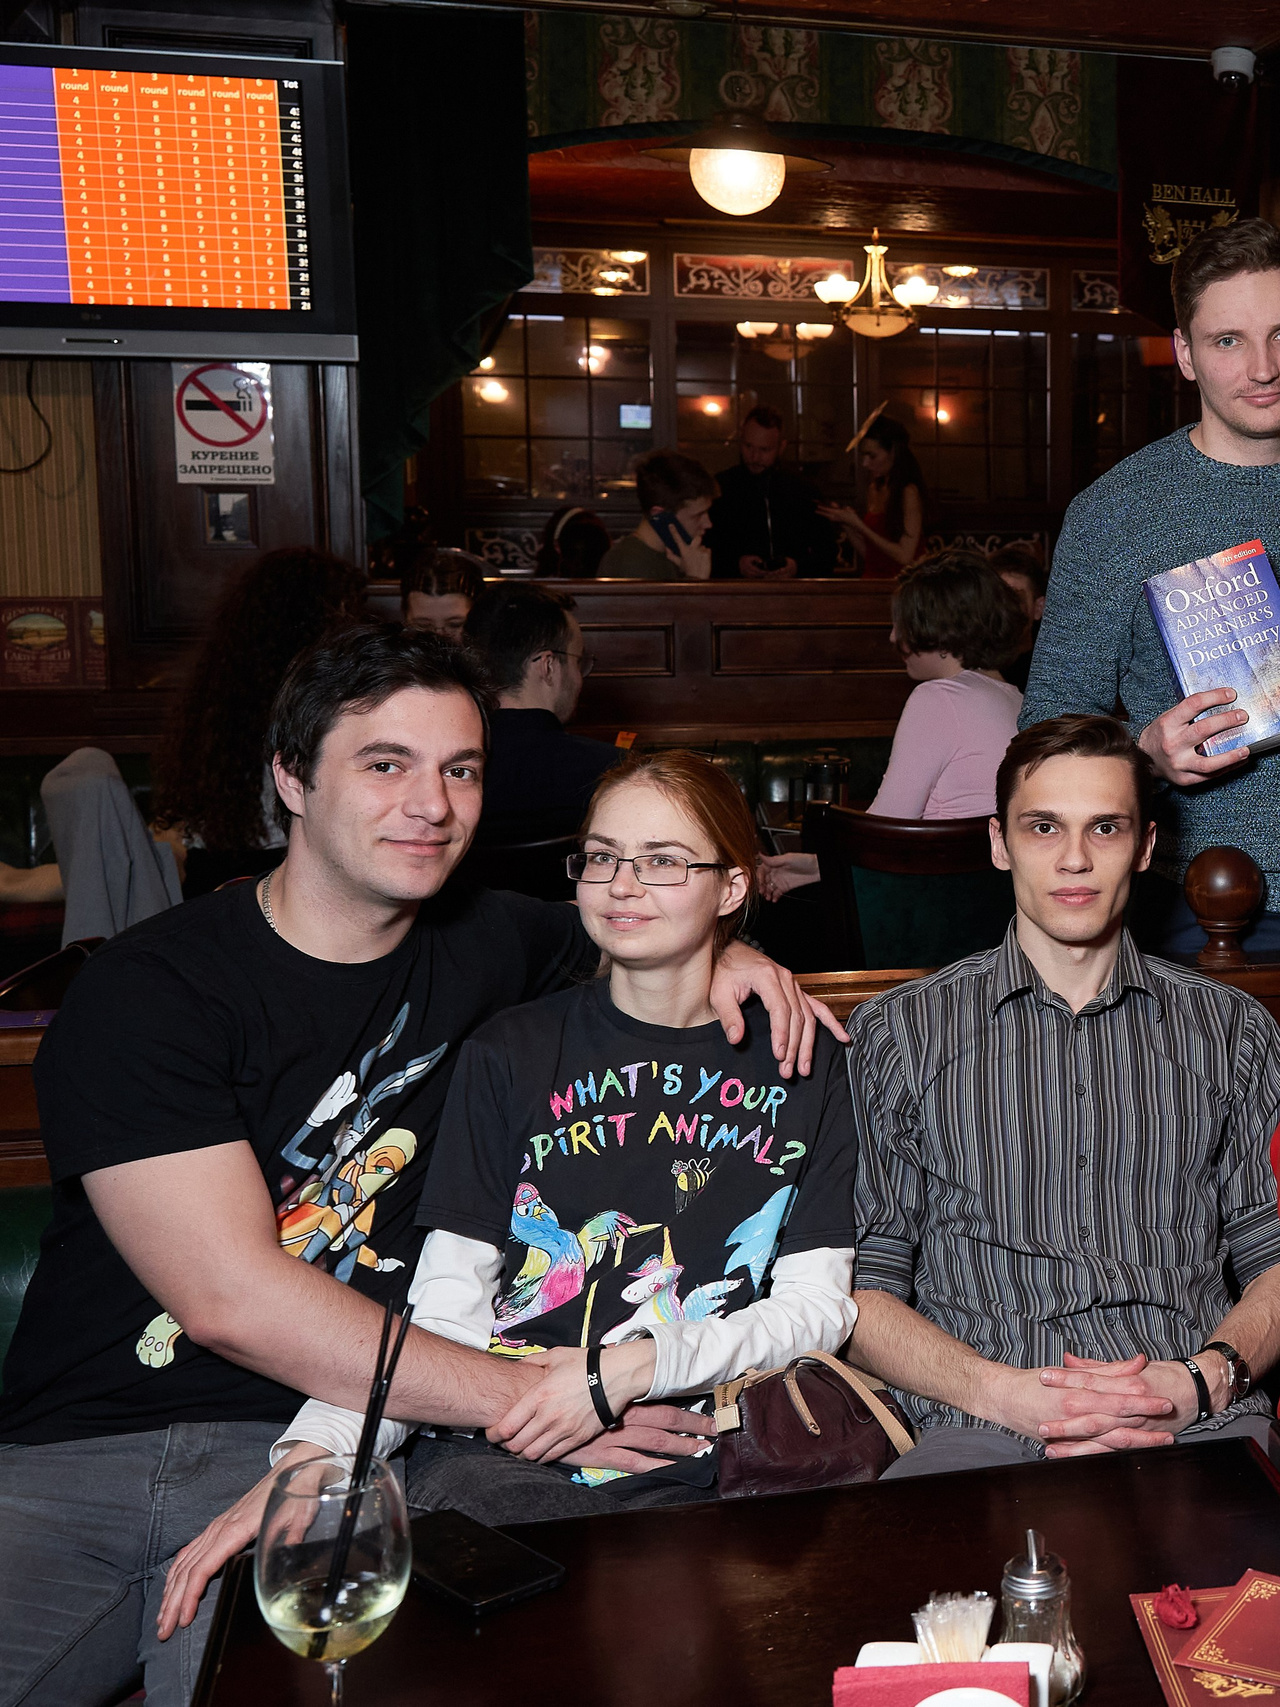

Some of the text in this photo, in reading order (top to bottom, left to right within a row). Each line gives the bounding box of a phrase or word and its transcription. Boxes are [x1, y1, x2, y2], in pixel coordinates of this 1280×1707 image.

[72, 69, 79, 77] 1
[110, 71, 117, 79] 2
[187, 75, 195, 83] 4
[223, 77, 231, 85] 5
[255, 79, 263, 87] 6
[61, 82, 89, 91] round
[100, 84, 129, 93] round
[140, 86, 168, 95] round
[177, 88, 205, 97] round
[212, 90, 240, 99] round
[246, 92, 274, 101] round
[72, 96, 80, 105] 4
[112, 98, 119, 107] 7
[152, 100, 160, 109] 8
[189, 102, 196, 111] 8
[223, 103, 231, 113] 8
[257, 105, 265, 115] 8
[73, 110, 81, 119] 4
[113, 112, 121, 121] 6
[153, 114, 160, 123] 8
[190, 116, 197, 125] 8
[224, 117, 232, 126] 8
[258, 119, 266, 129] 8
[74, 123, 82, 132] 4
[114, 125, 121, 134] 7
[154, 127, 161, 136] 8
[191, 129, 198, 138] 8
[225, 131, 233, 141] 8
[259, 132, 266, 142] 7
[75, 137, 83, 146] 4
[115, 139, 122, 148] 7
[155, 140, 162, 150] 8
[192, 142, 199, 151] 7
[226, 144, 234, 154] 8
[259, 146, 267, 155] 6
[77, 151, 84, 160] 4
[116, 152, 124, 162] 8
[155, 154, 163, 163] 8
[192, 156, 200, 165] 8
[227, 158, 235, 167] 6
[261, 159, 268, 168] 7
[78, 164, 85, 173] 4
[117, 166, 125, 175] 6
[156, 167, 164, 177] 8
[228, 171, 236, 181] 8
[261, 173, 269, 182] 8
[79, 178, 270, 195] 4 6 8 8 6 7
[1151, 183, 1236, 204] BEN HALL
[80, 191, 270, 208] 4 8 8 8 4 7
[81, 206, 88, 215] 4
[159, 209, 167, 218] 8
[196, 210, 204, 220] 6
[230, 211, 238, 221] 6
[264, 213, 271, 222] 8
[82, 221, 272, 237] 4 6 8 7 4 7
[83, 236, 273, 251] 4 7 7 8 2 7
[84, 251, 274, 266] 4 7 8 6 4 6
[85, 265, 275, 280] 4 2 8 4 4 7
[86, 280, 94, 290] 4
[125, 282, 133, 290] 4
[164, 283, 172, 292] 8
[235, 285, 242, 294] 2
[268, 286, 276, 295] 6
[165, 297, 173, 307] 8
[236, 299, 243, 309] 2
[191, 451, 260, 461] КУРЕНИЕ
[179, 464, 272, 475] ЗАПРЕЩЕНО
[1233, 548, 1257, 560] edition
[1165, 562, 1262, 613] Oxford
[1176, 589, 1269, 632] ADVANCED
[1182, 605, 1274, 649] LEARNER'S
[1186, 624, 1280, 668] Dictionary
[549, 1060, 788, 1128] WHAT'S YOUR
[587, 1372, 599, 1387] 28
